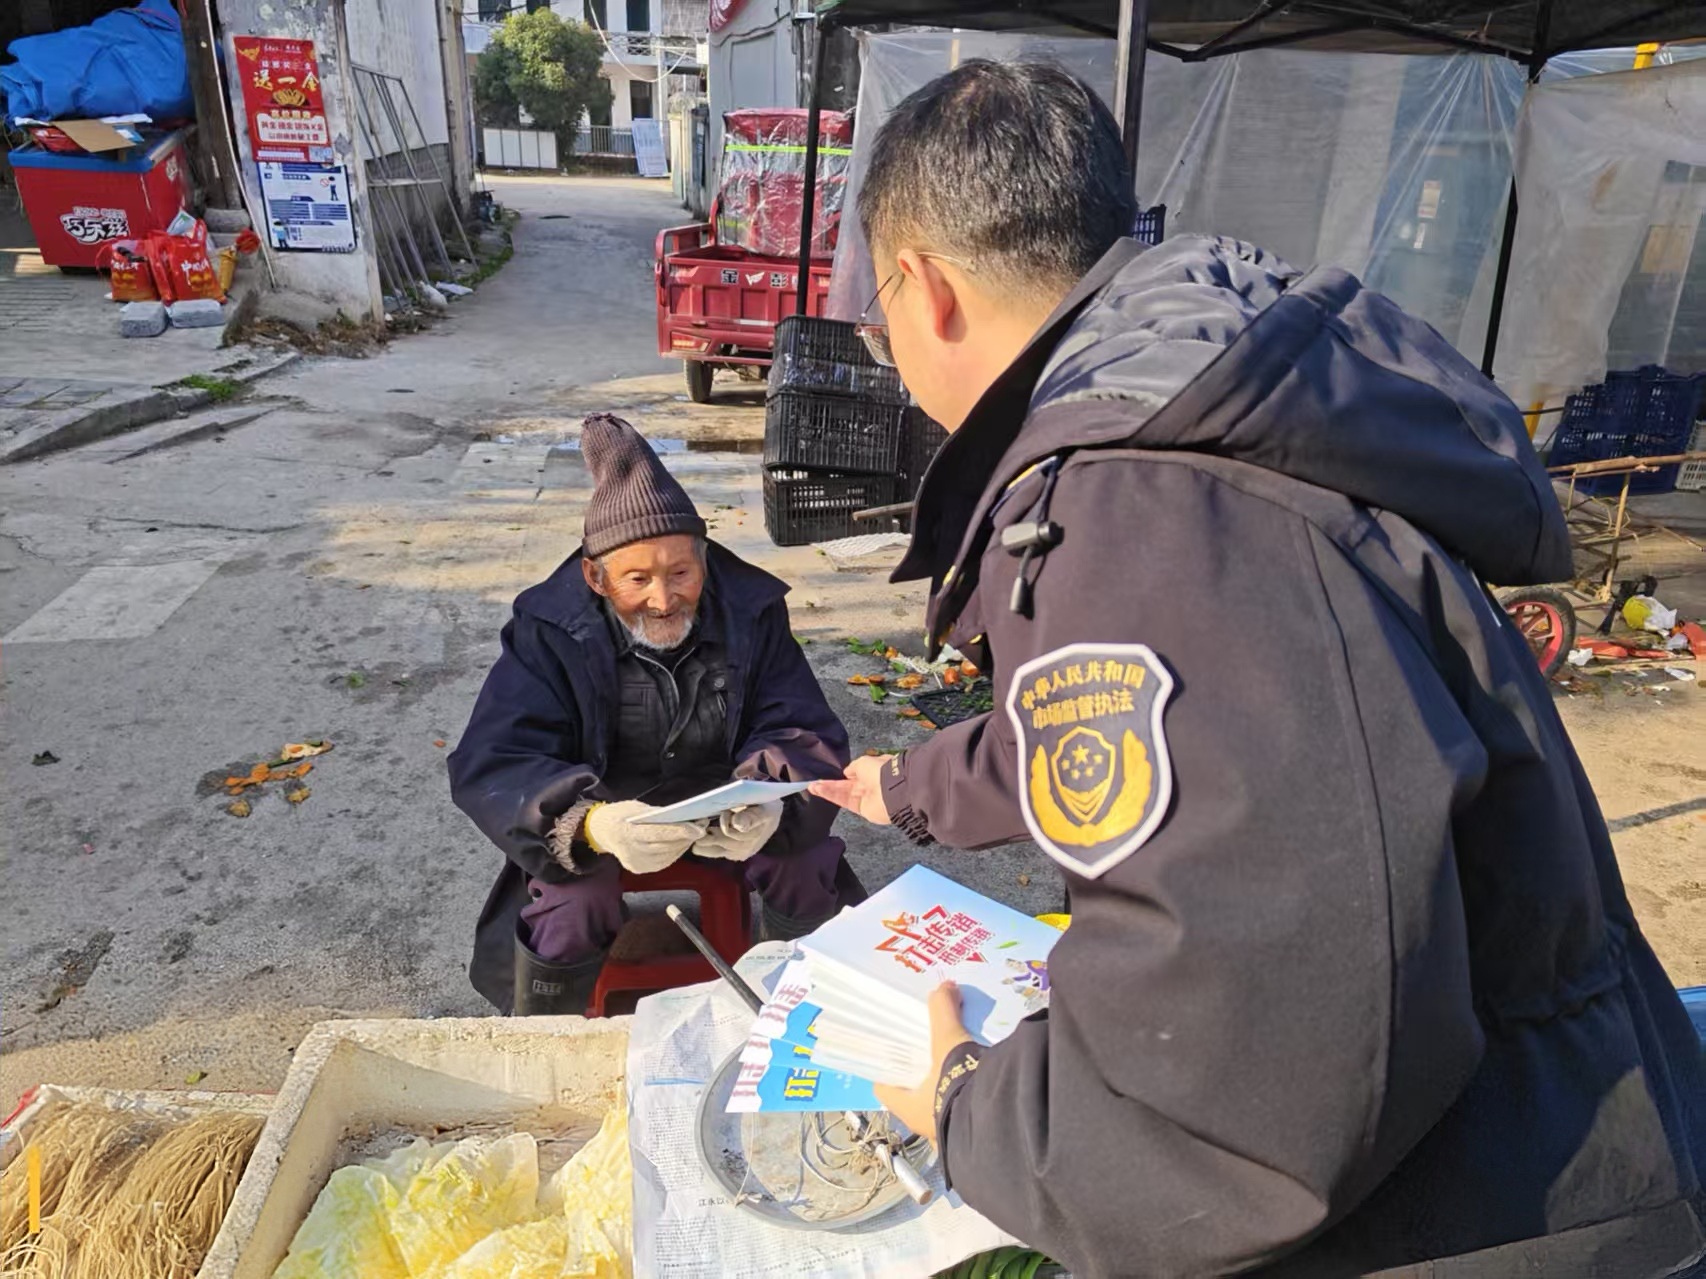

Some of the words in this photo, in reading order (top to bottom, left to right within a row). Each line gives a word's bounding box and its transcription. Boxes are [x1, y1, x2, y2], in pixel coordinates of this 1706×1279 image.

[61, 215, 129, 242] 巧乐兹
[1022, 660, 1146, 709] 中华人民共和国
[893, 912, 979, 973] 打击传销
